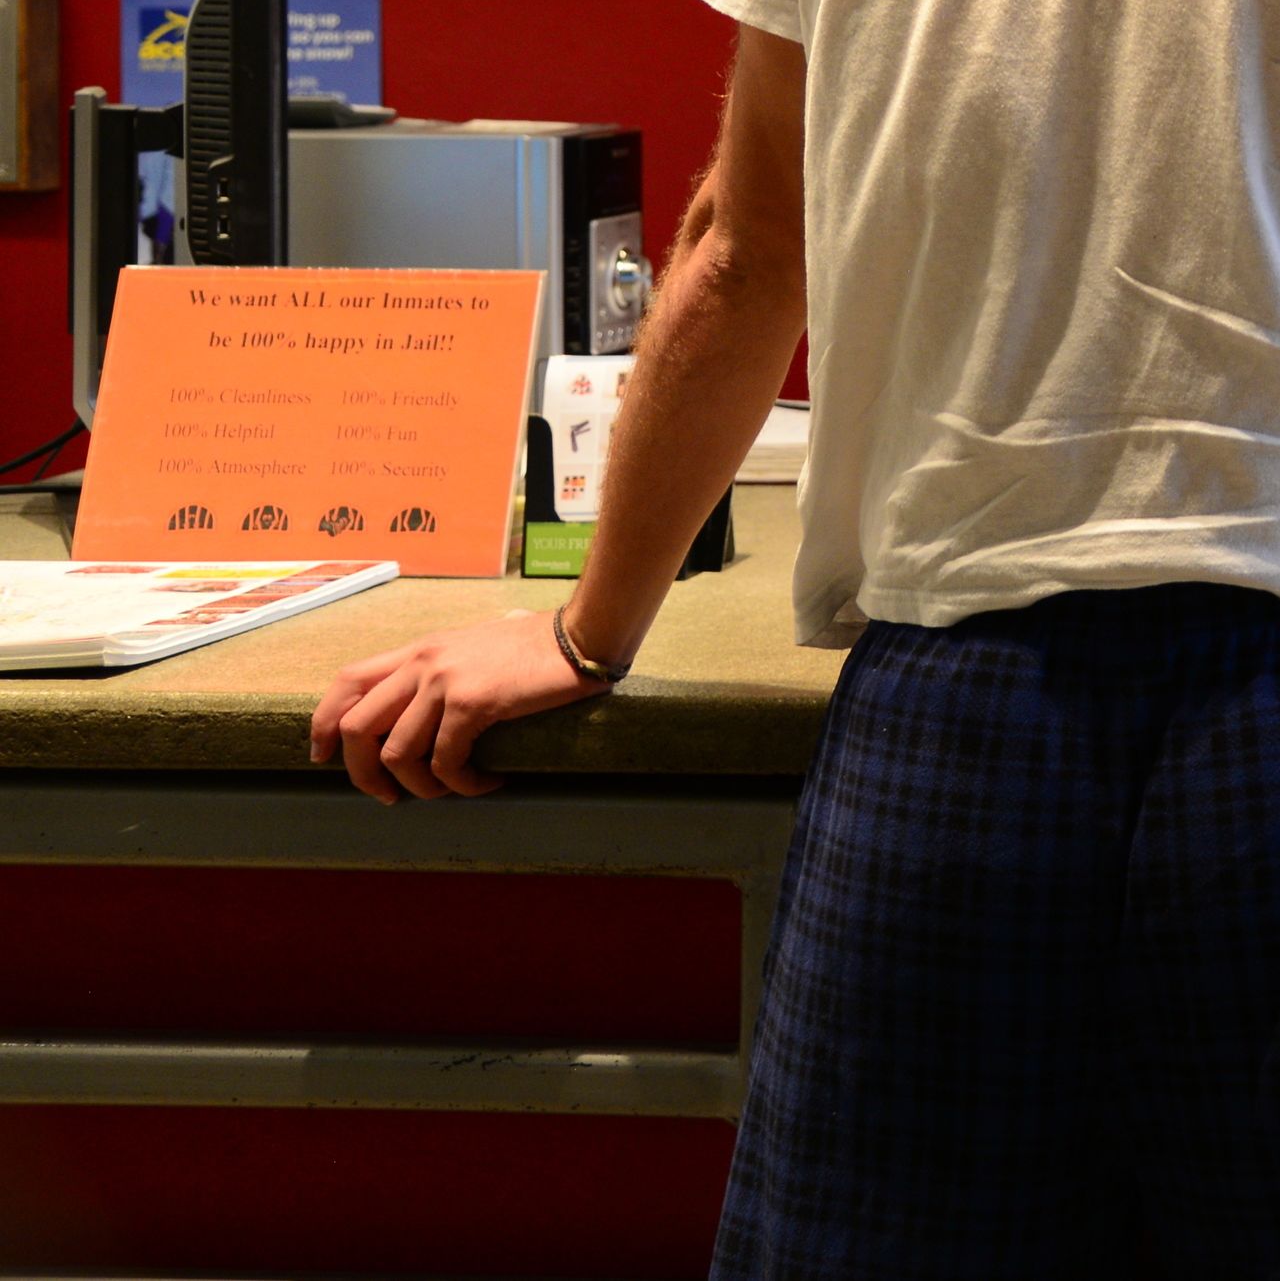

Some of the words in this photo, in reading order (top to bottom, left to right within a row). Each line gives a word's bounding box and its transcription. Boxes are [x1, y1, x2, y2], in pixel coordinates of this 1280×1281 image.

[189, 289, 222, 308] We
[229, 291, 277, 308] want
[285, 291, 333, 309] ALL
[339, 294, 375, 309] our
[382, 291, 464, 310] Inmates
[471, 294, 491, 311] to
[209, 331, 232, 349] be
[240, 330, 297, 350] 100%
[305, 332, 367, 354] happy
[375, 333, 395, 351] in
[400, 333, 456, 352] Jail!!
[169, 387, 214, 404] 100%
[219, 388, 312, 405] Cleanliness
[341, 388, 387, 406] 100%
[392, 389, 459, 411] Friendly
[163, 422, 208, 439] 100%
[214, 423, 276, 444] Helpful
[336, 423, 382, 441] 100%
[386, 425, 418, 442] Fun
[157, 457, 203, 475] 100%
[207, 458, 307, 479] Atmosphere
[330, 460, 377, 477] 100%
[382, 460, 449, 482] Security
